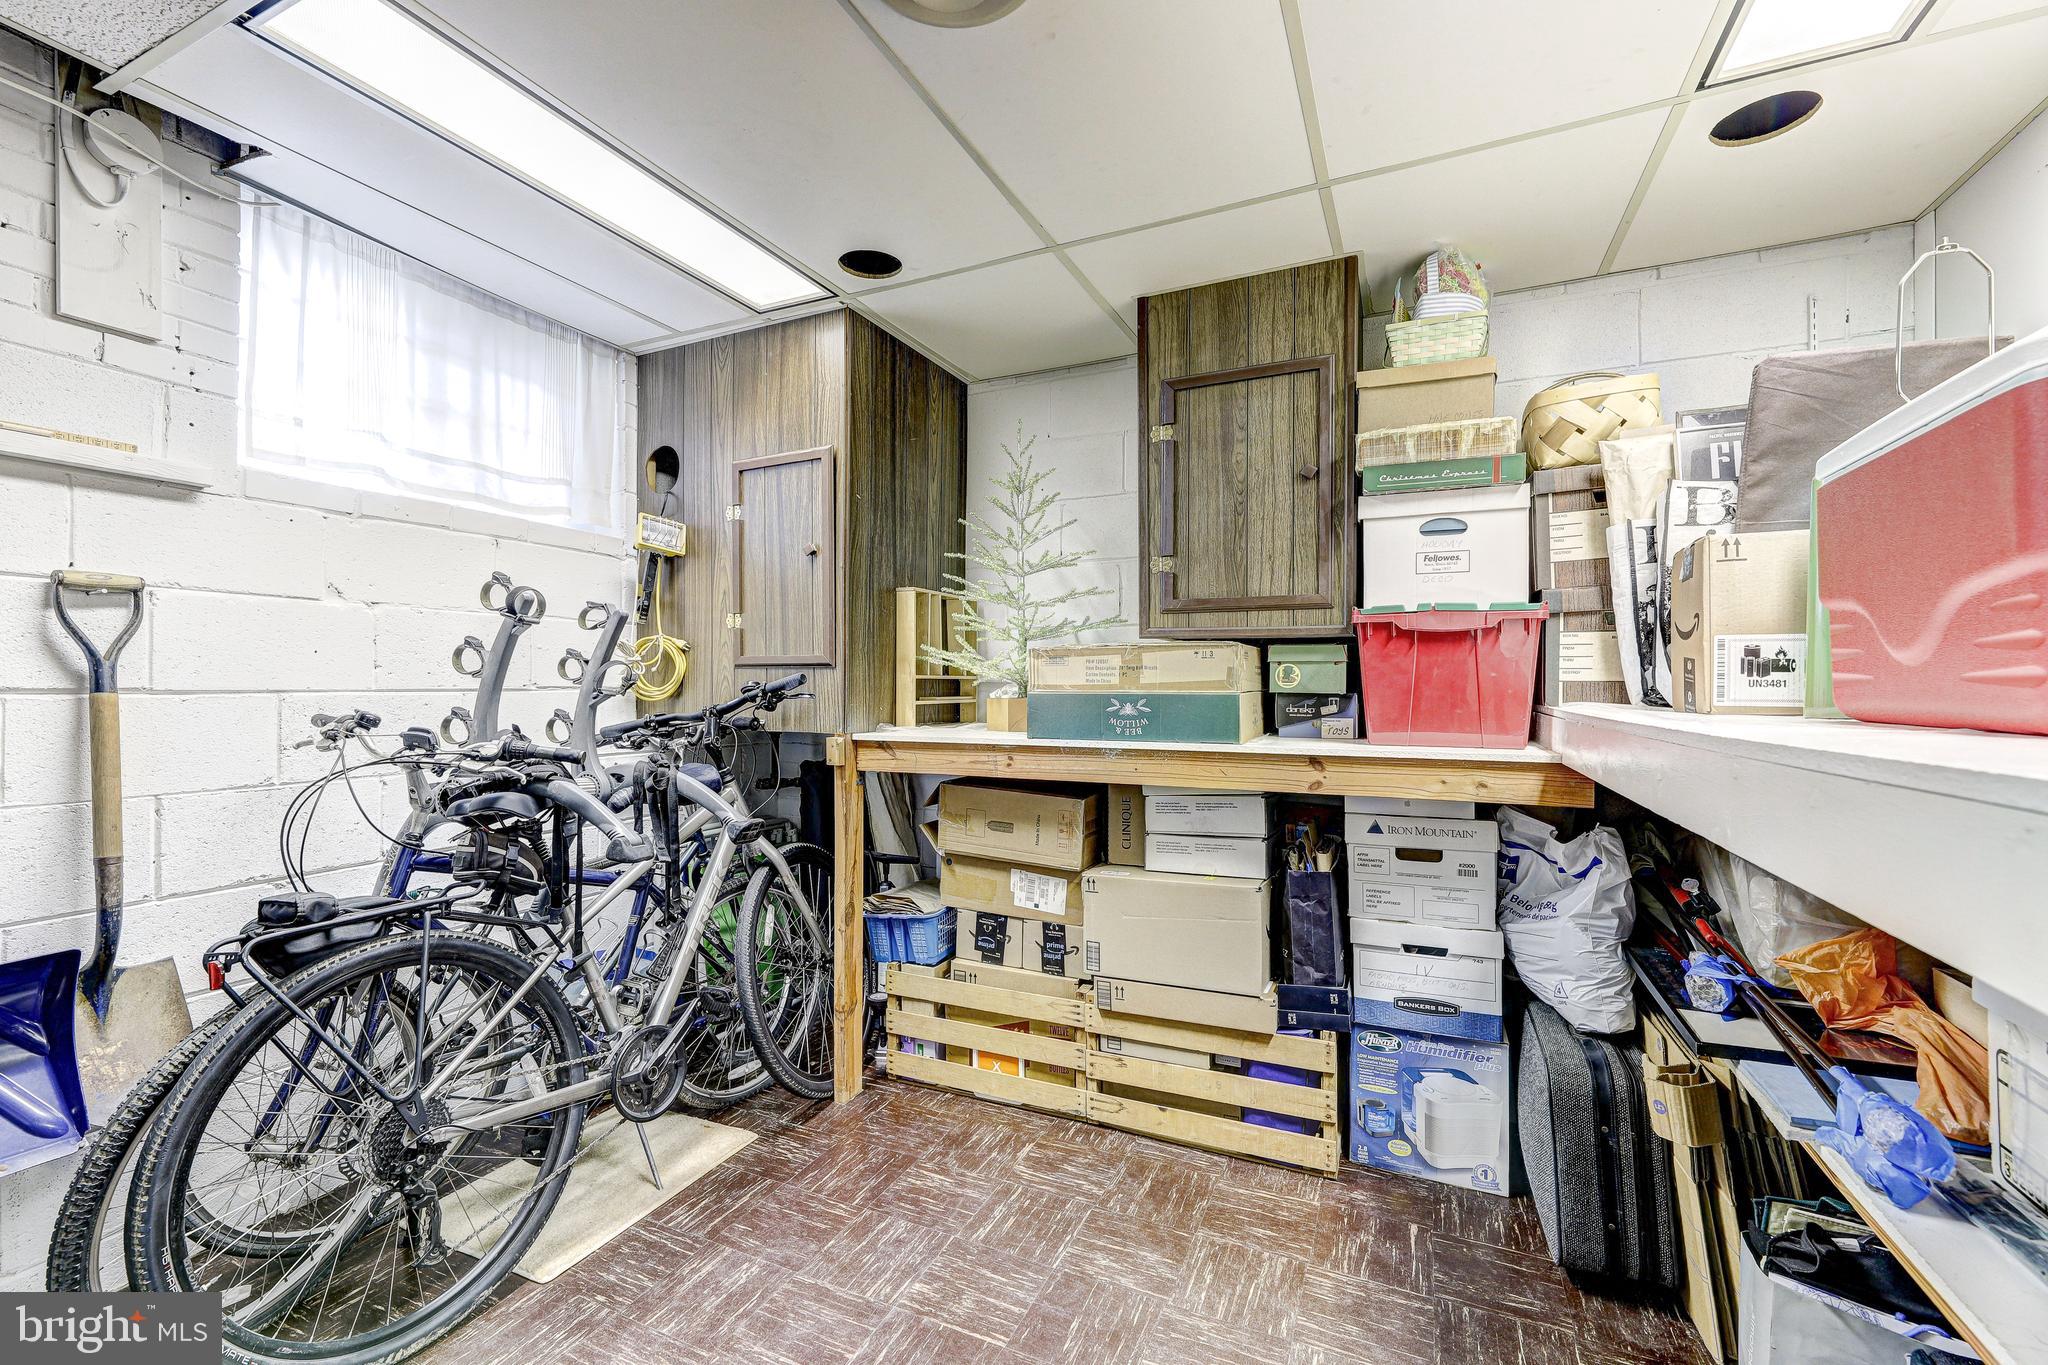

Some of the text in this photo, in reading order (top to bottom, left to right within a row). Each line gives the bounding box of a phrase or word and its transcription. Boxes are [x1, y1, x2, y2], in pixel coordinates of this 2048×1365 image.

[1748, 679, 1787, 688] UN3481
[1286, 704, 1316, 713] dansko
[1108, 717, 1149, 728] WILLOW
[1327, 726, 1350, 736] TOYS
[1121, 796, 1133, 850] CLINIQUE
[1387, 825, 1413, 835] IRON
[977, 941, 995, 949] prime
[1398, 1001, 1436, 1011] BANKERS
[534, 1004, 561, 1049] BONTRAGER
[1361, 1032, 1399, 1050] HUNTER
[1406, 1041, 1494, 1063] Humidifier
